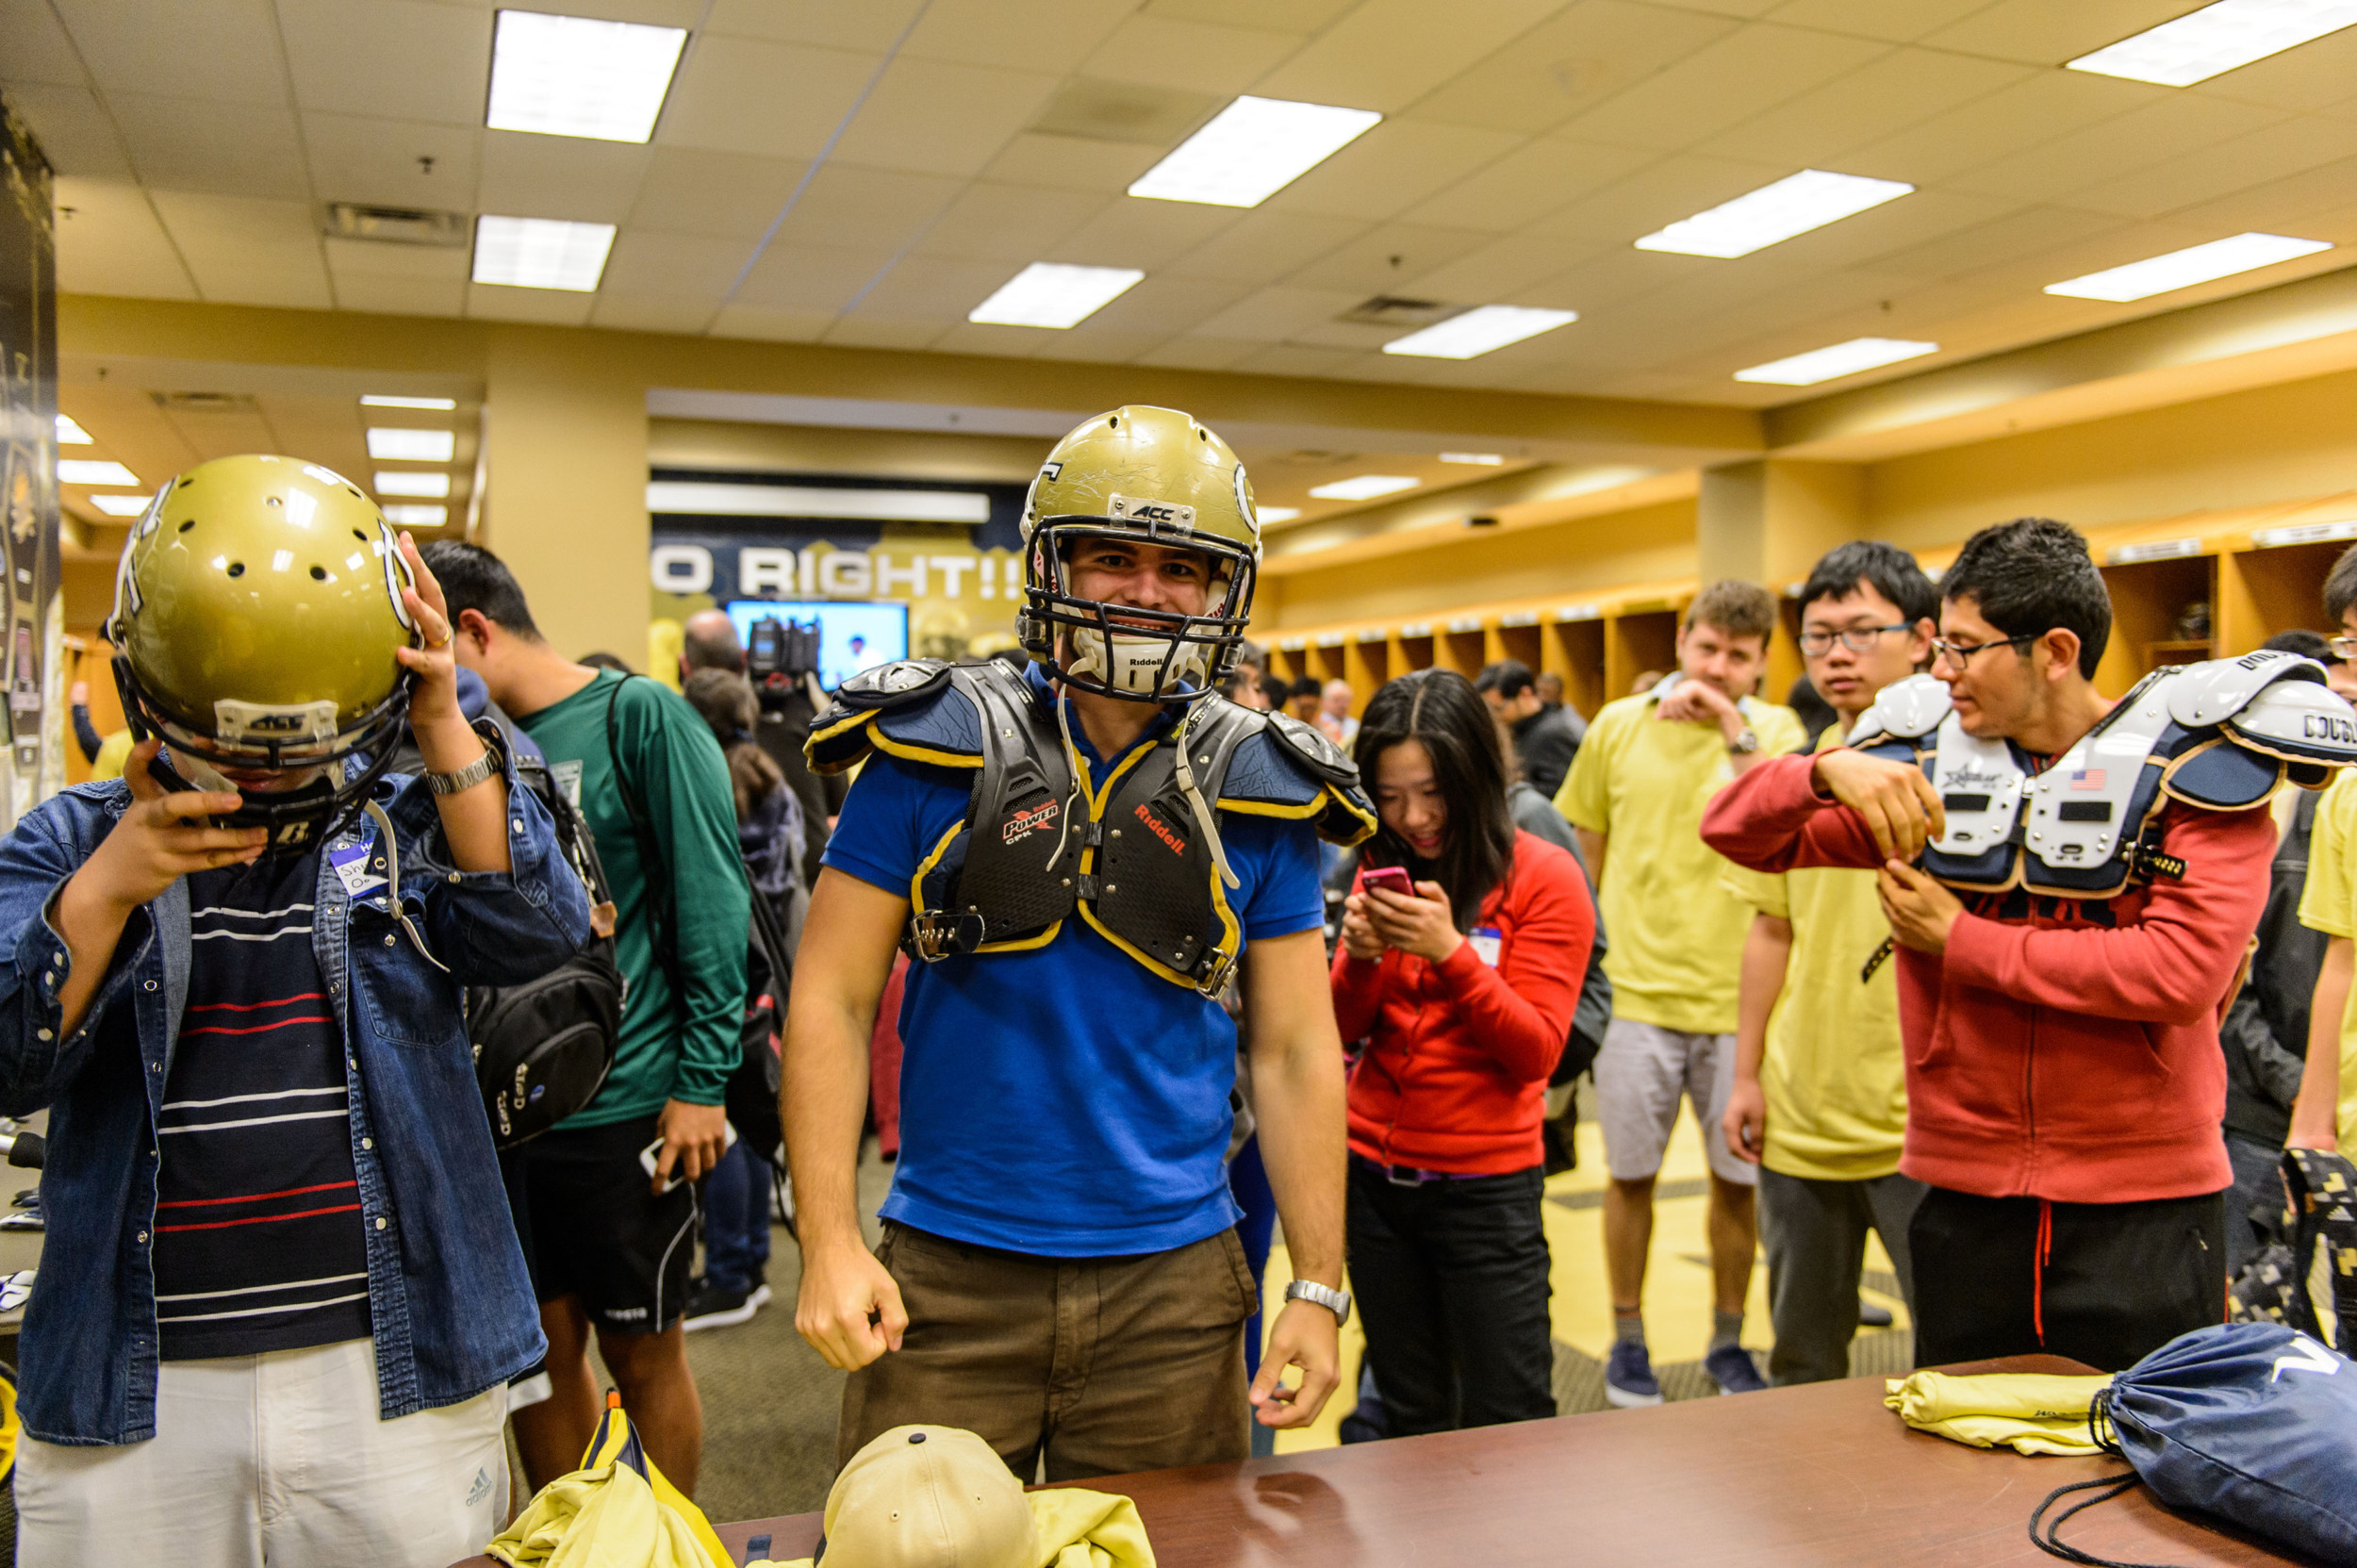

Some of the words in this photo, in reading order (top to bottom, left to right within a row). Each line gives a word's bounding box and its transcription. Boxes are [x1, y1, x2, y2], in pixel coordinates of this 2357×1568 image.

[1132, 504, 1175, 521] ACC
[1129, 658, 1163, 667] Riddell
[249, 714, 306, 731] ACC
[1033, 798, 1057, 813] Riddell
[1003, 804, 1059, 839] POWER
[1134, 803, 1187, 856] Riddell
[1005, 831, 1033, 846] CPK
